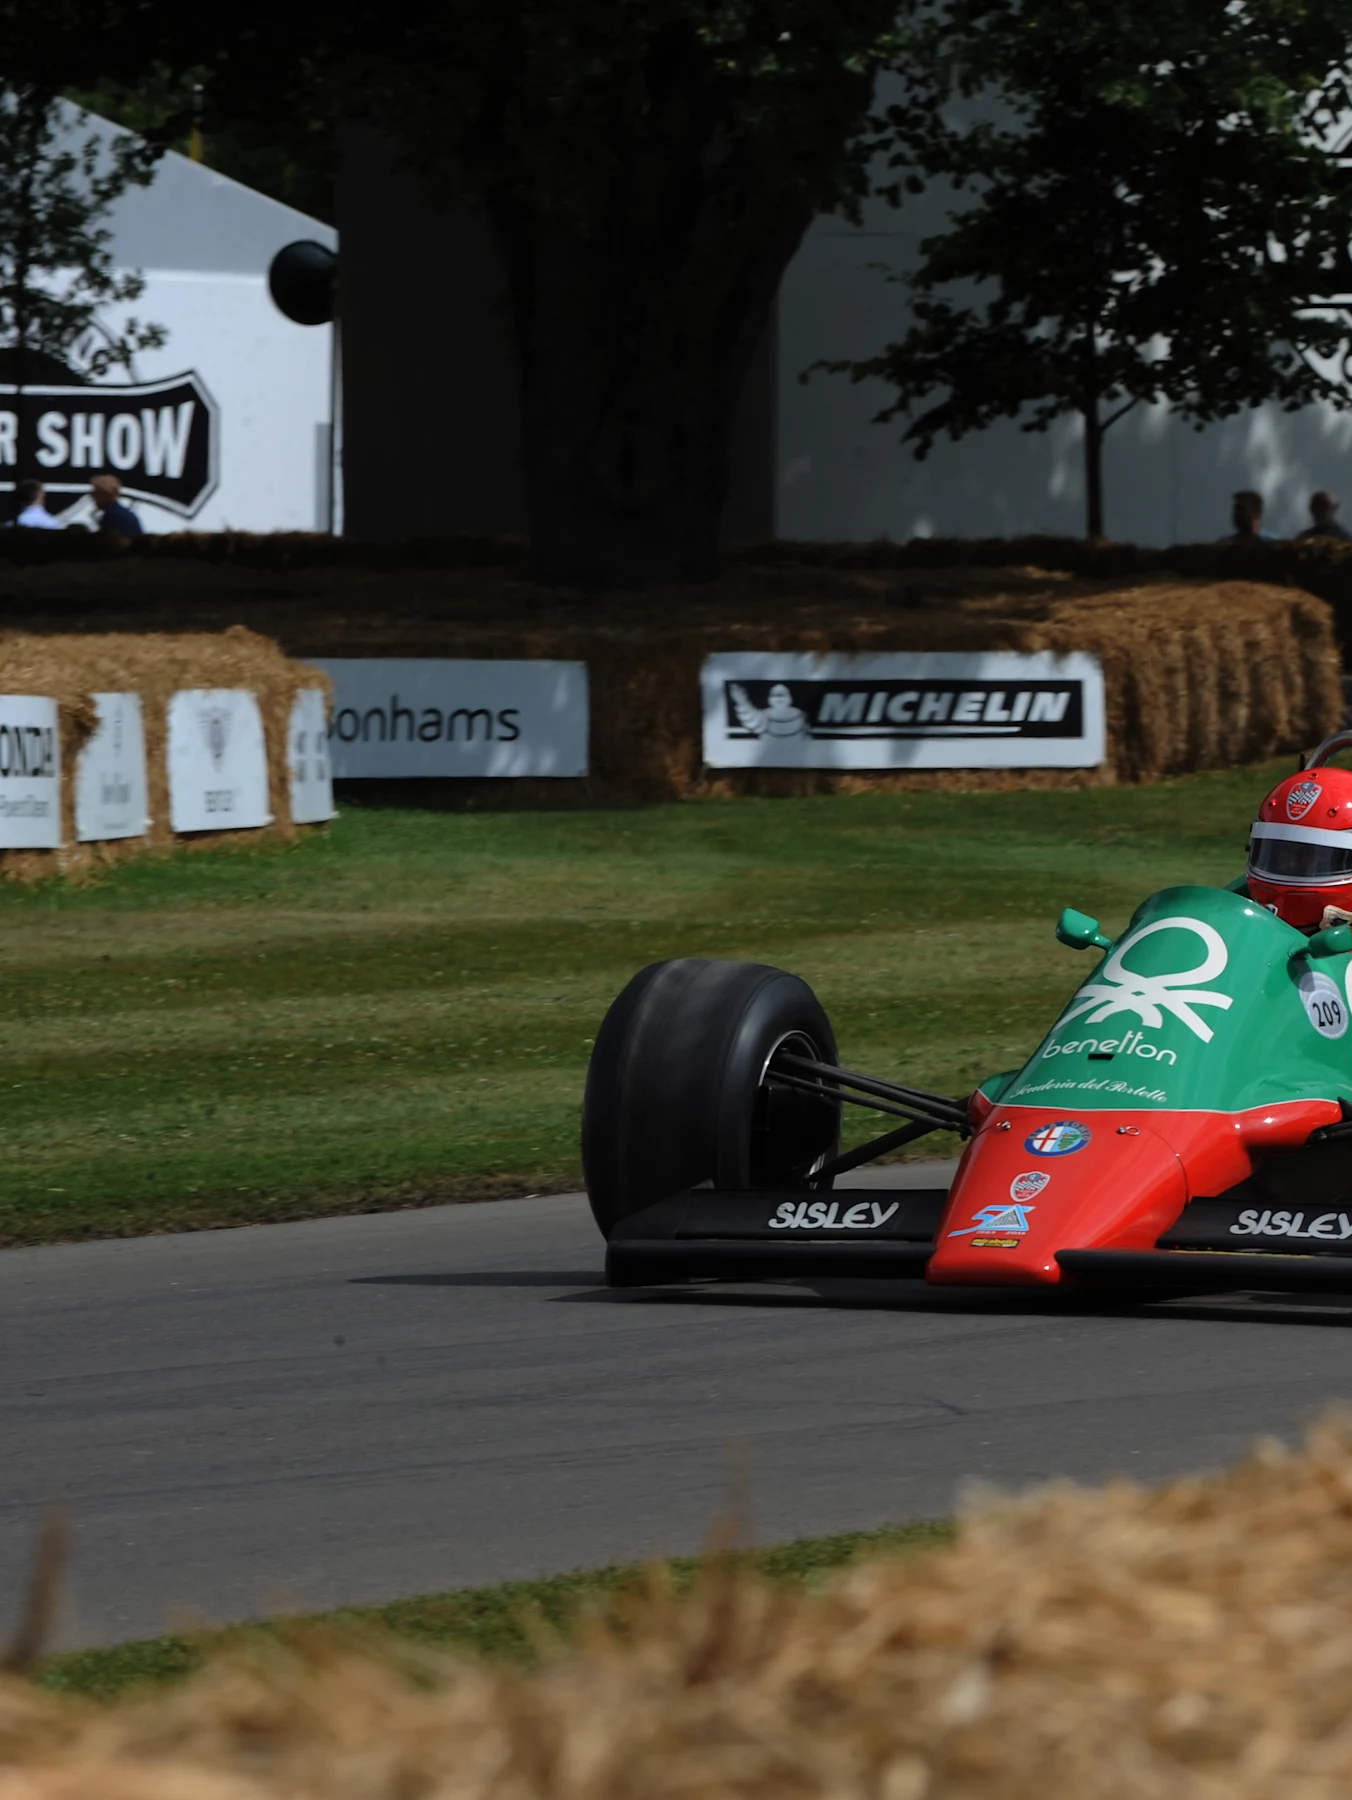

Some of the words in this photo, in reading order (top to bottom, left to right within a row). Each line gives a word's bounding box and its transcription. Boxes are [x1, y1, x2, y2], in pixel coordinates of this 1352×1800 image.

[35, 400, 195, 479] SHOW
[328, 693, 521, 742] onhams
[817, 690, 1071, 724] MICHELIN
[1312, 999, 1342, 1028] 209
[1042, 1030, 1177, 1066] benetton
[768, 1201, 900, 1230] SISLEY
